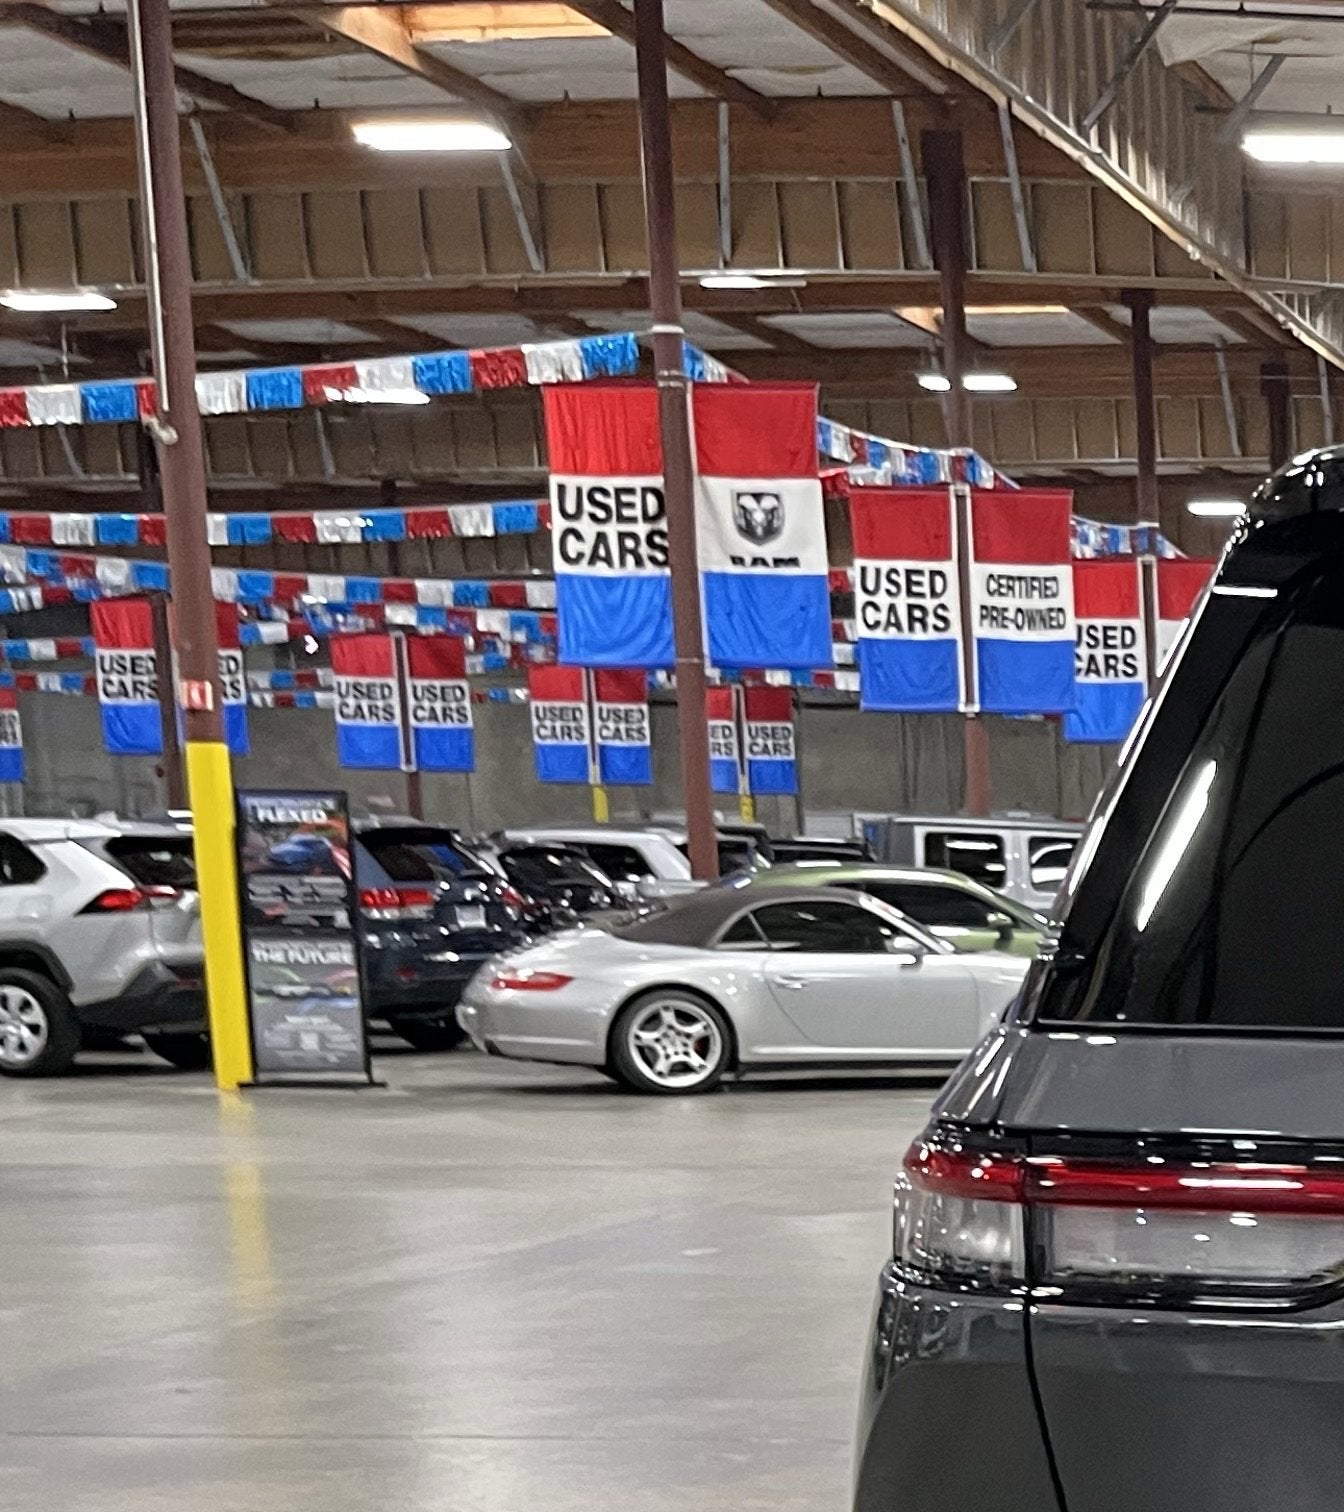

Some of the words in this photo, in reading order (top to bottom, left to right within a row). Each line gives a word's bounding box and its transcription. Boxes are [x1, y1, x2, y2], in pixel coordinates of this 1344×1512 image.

[557, 483, 666, 524] USED
[559, 527, 669, 569] CARS
[860, 565, 948, 599] USED
[986, 573, 1060, 599] CERTIFIED
[861, 601, 951, 633] CARS
[979, 604, 1067, 631] PRE-OWNED
[102, 679, 159, 699] CARS
[336, 681, 393, 700] USED
[411, 684, 466, 703] USED
[339, 702, 395, 722] CARS
[413, 705, 469, 724] CARS
[534, 705, 583, 722] USED
[599, 705, 645, 723] USED
[536, 724, 586, 741] CARS
[600, 724, 648, 741] CARS
[747, 725, 792, 740] USED
[748, 742, 792, 757] CARS
